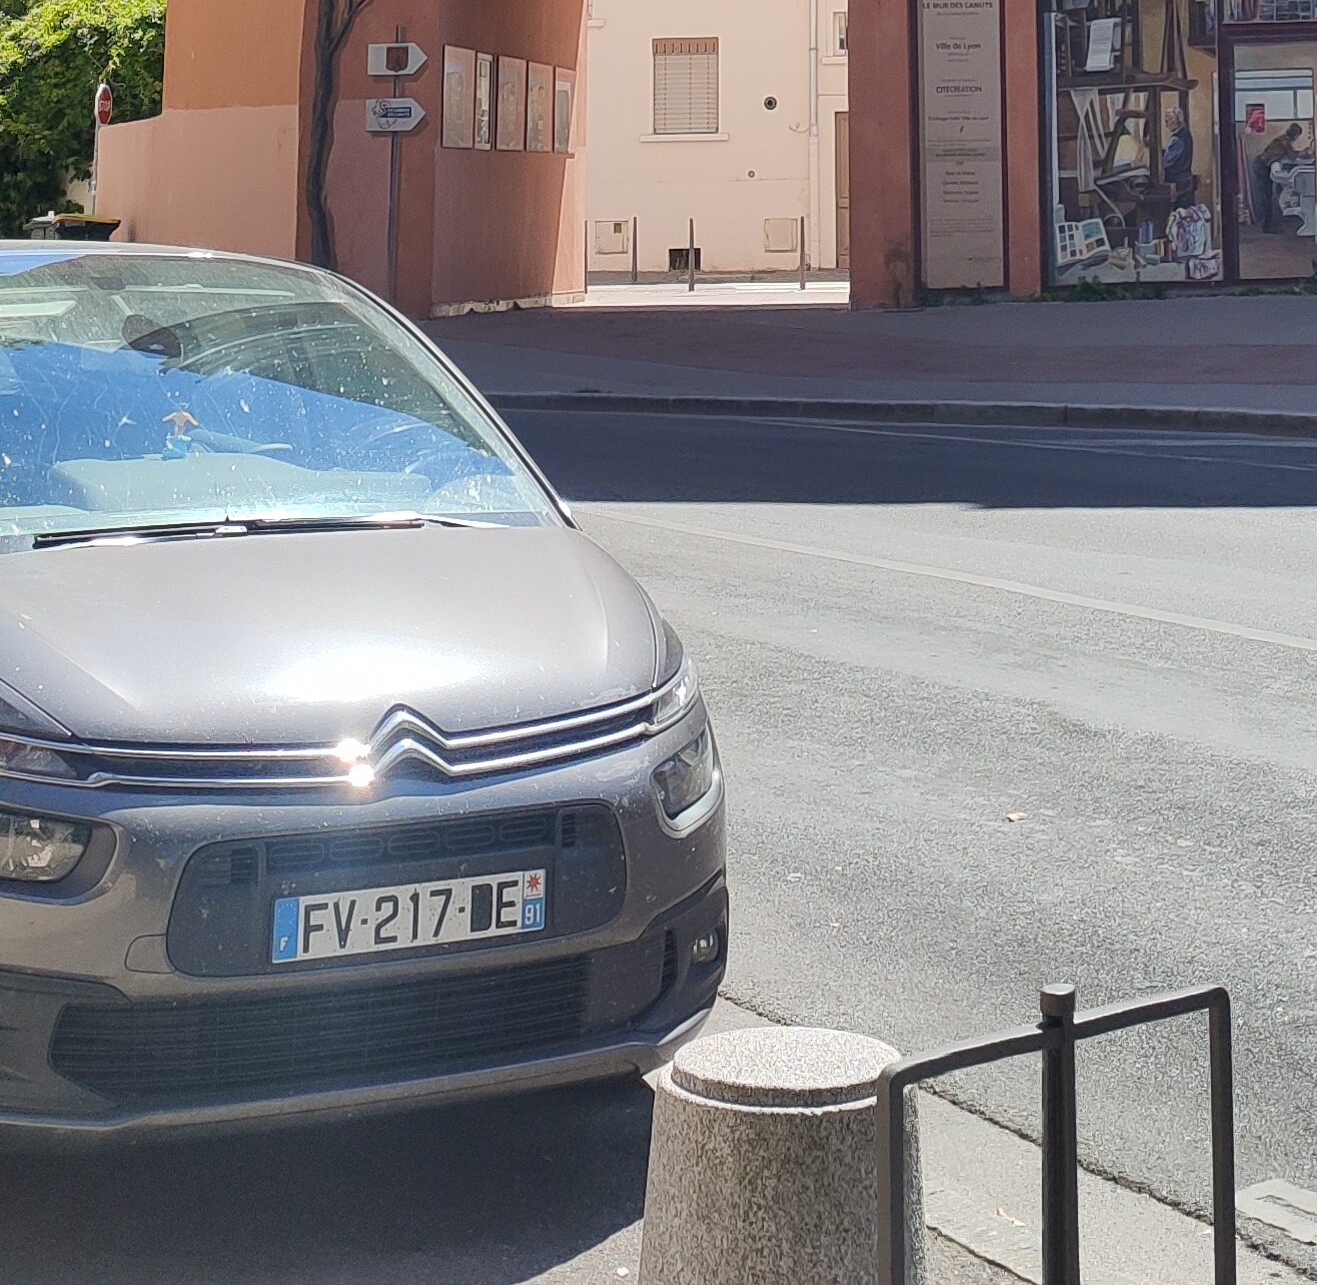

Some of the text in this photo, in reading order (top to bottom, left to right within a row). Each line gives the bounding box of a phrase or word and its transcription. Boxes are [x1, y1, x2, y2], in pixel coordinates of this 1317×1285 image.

[964, 43, 981, 51] Lyon
[524, 904, 541, 925] 91
[279, 936, 289, 953] F
